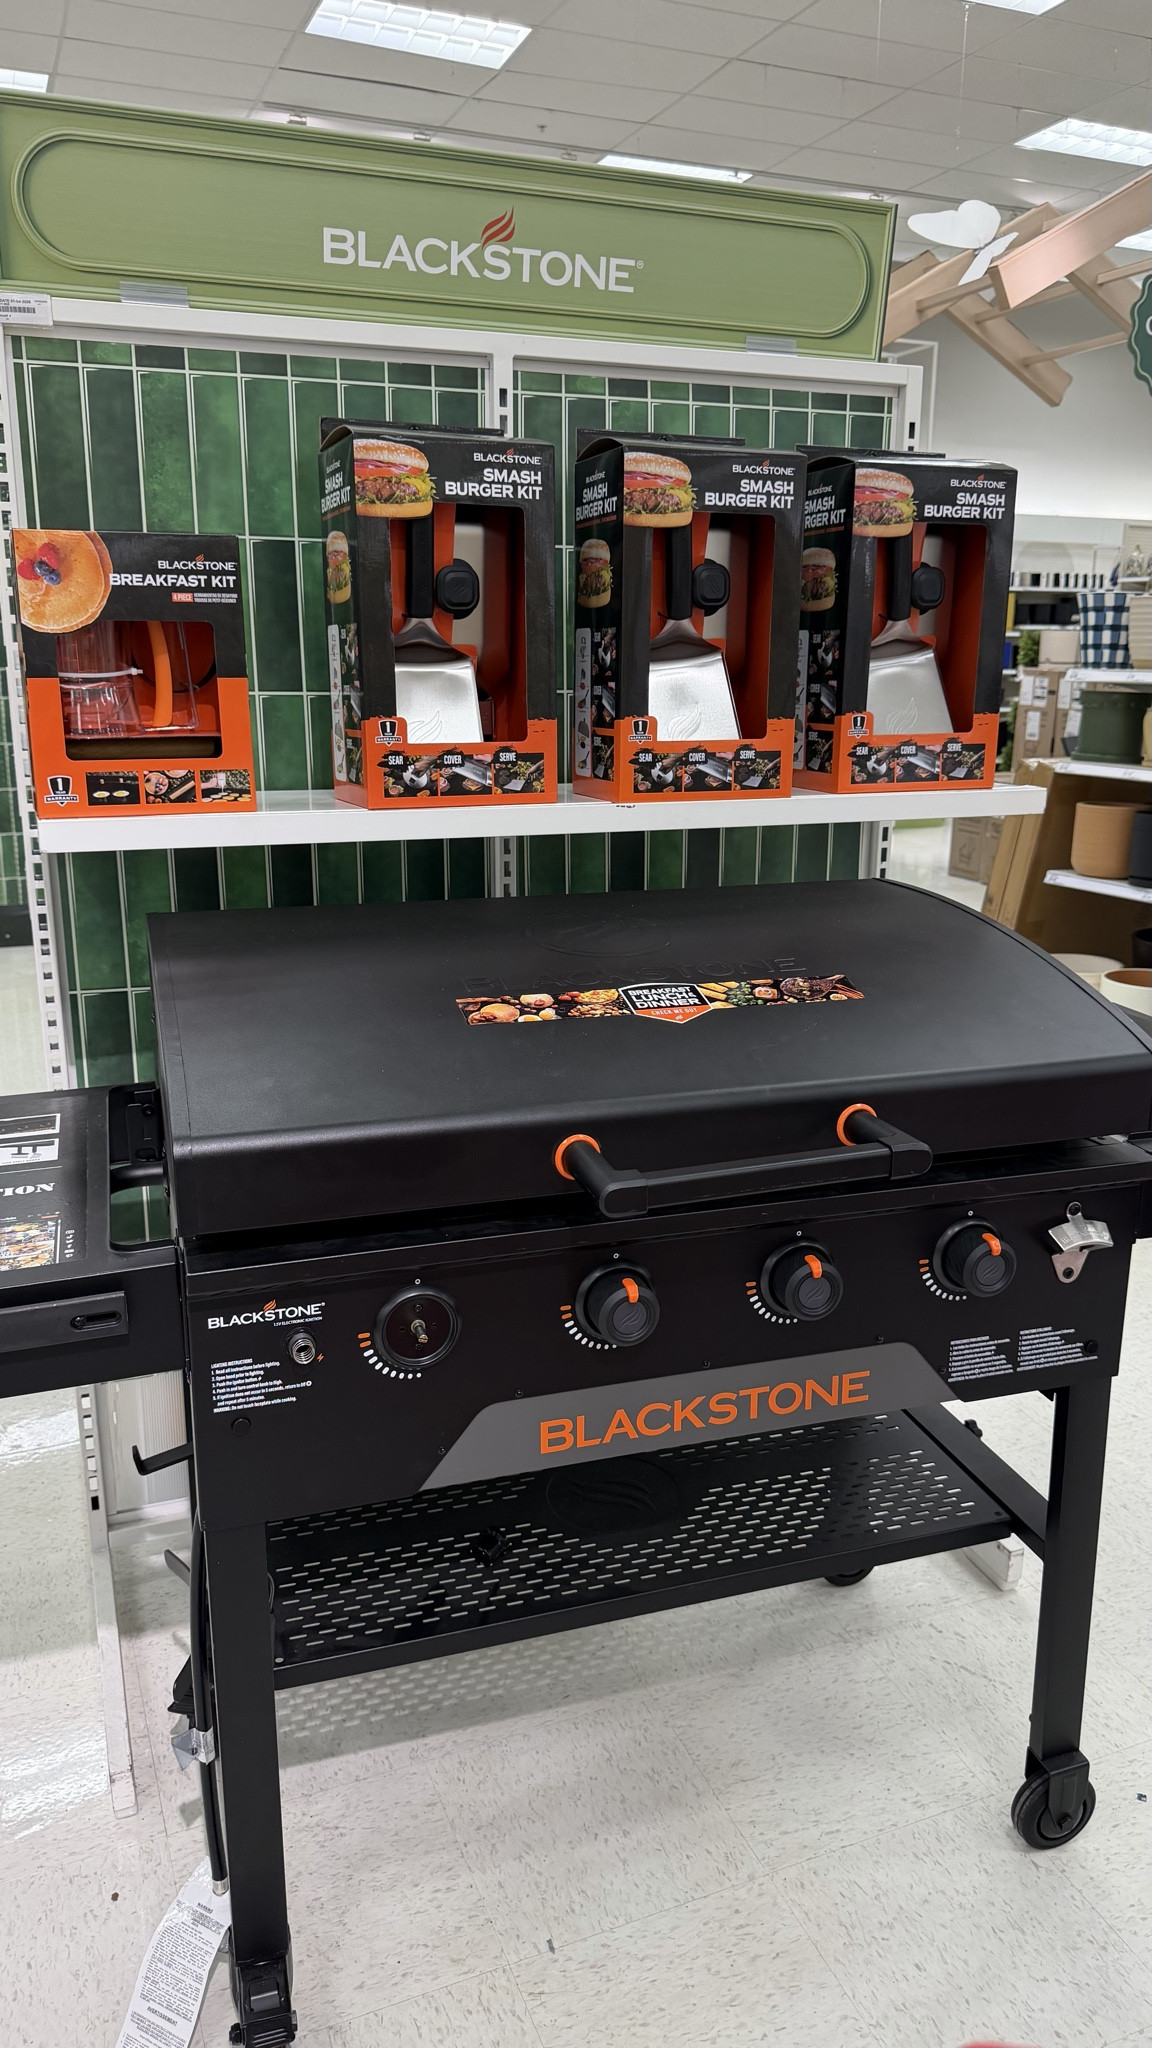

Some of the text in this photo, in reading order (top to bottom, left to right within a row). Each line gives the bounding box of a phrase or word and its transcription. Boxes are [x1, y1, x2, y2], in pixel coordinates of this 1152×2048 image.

[474, 452, 542, 465] BLACKSTONE
[483, 468, 542, 484] SMASH
[732, 464, 794, 476] BLACKSTONE
[325, 471, 343, 494] SMASH
[740, 478, 794, 495] SMASH
[950, 478, 1006, 490] BLACKSTONE
[444, 481, 542, 500] BURGER KIT
[582, 481, 608, 504] SMASH
[321, 491, 341, 514] BURGER
[340, 486, 350, 504] KIT
[704, 492, 794, 510] BURGER KIT
[804, 495, 835, 514] SMASH
[956, 492, 1006, 506] SMASH
[576, 500, 603, 522] BURGER
[604, 496, 618, 514] KIT
[924, 504, 1006, 520] BURGER KIT
[804, 508, 846, 529] RGER KIT
[158, 560, 236, 571] BLACKSTONE
[109, 573, 236, 588] BREAKFAST KIT
[386, 722, 390, 732] 1
[639, 721, 642, 731] 1
[857, 716, 860, 726] 1
[856, 747, 868, 756] SEAR
[901, 746, 916, 754] COVER
[947, 743, 962, 752] SERVE
[388, 755, 404, 766] SEAR
[444, 755, 462, 765] COVER
[499, 752, 516, 762] SERVE
[639, 752, 652, 763] SEAR
[689, 752, 705, 762] COVER
[740, 750, 756, 760] SERVE
[57, 778, 63, 790] 1
[628, 986, 691, 996] BREAKFAST
[632, 992, 687, 1002] LUNCH
[636, 998, 702, 1009] DINNER
[208, 1302, 322, 1329] BLACKSTONE
[540, 1370, 870, 1454] BLACKSTONE
